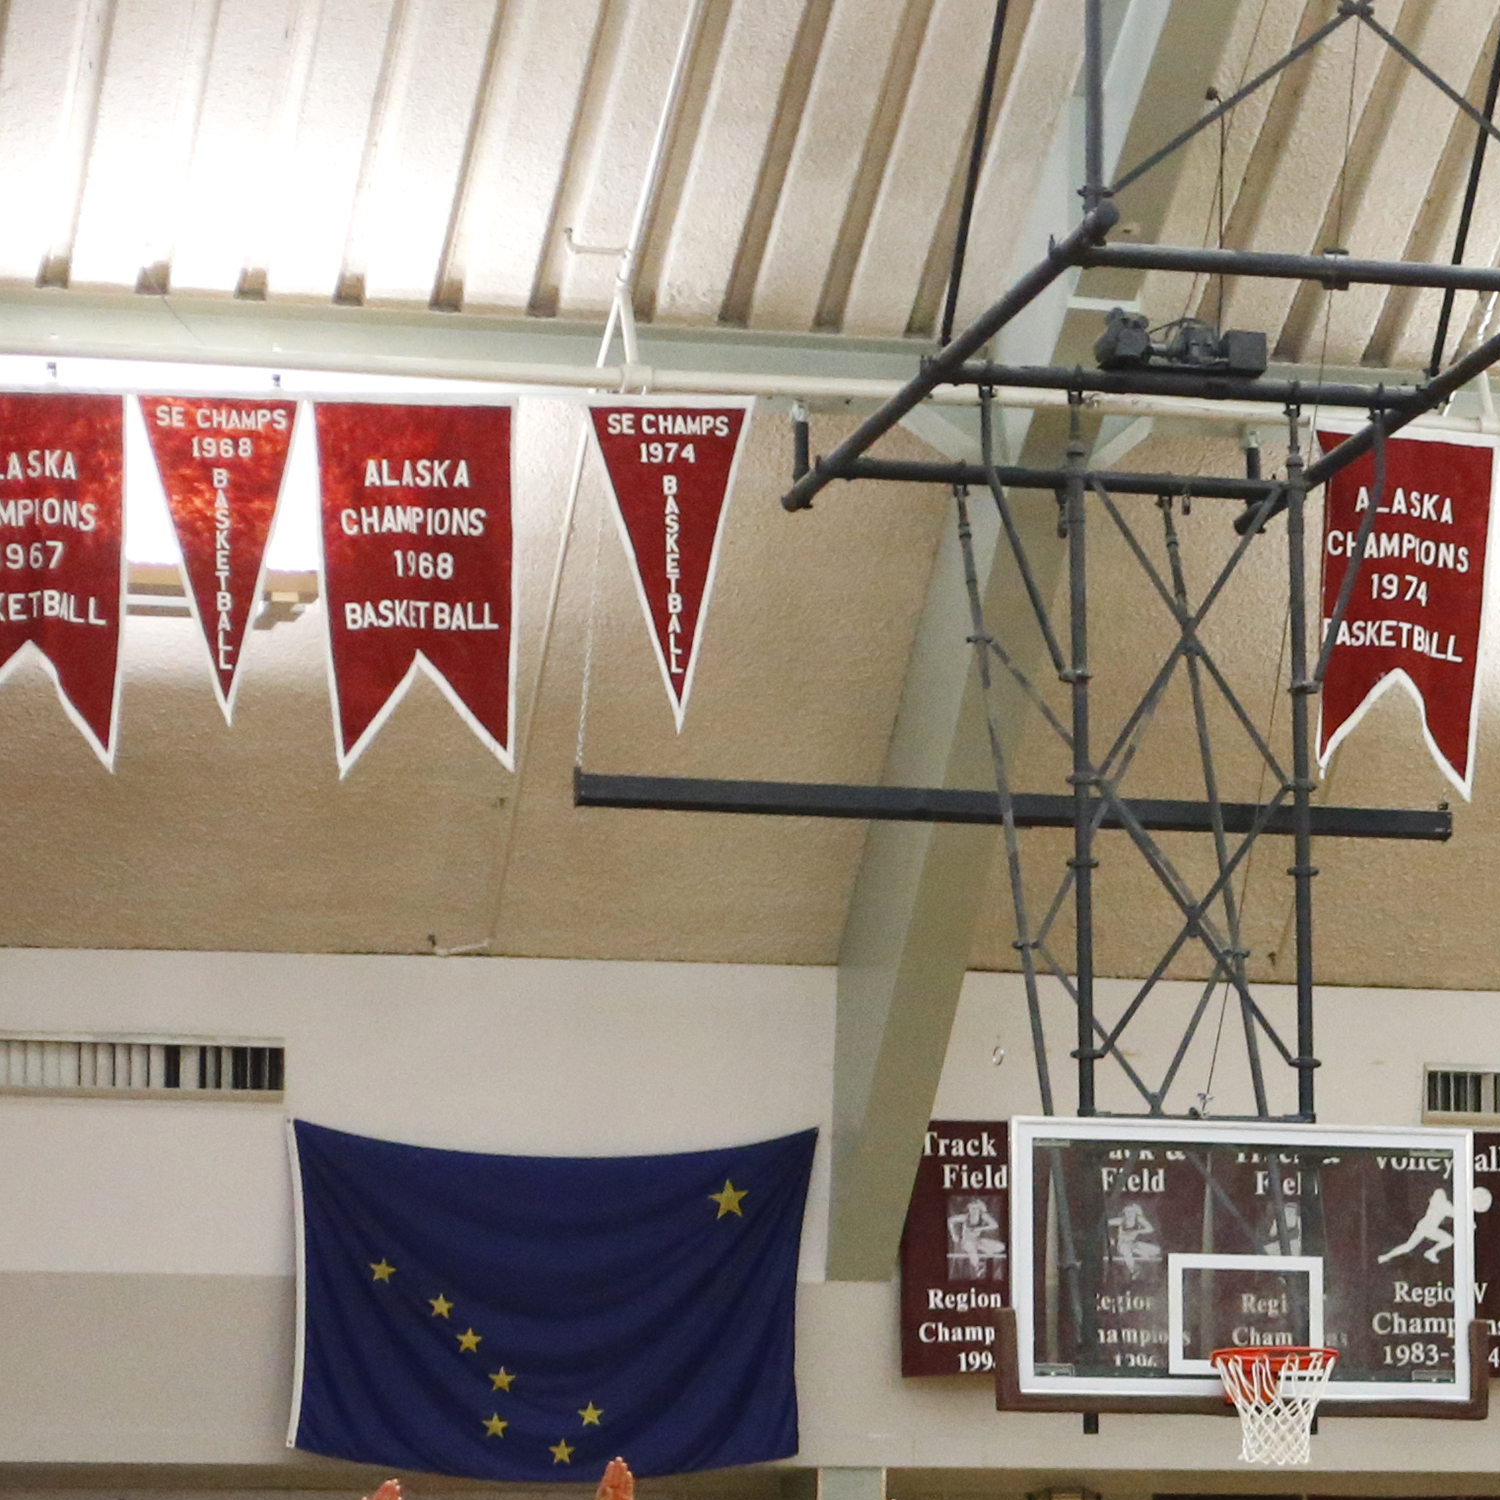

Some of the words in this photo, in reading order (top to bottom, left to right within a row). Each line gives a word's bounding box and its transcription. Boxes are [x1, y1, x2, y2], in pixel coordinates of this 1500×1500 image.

[156, 405, 185, 427] SE
[196, 409, 287, 430] CHAMPS
[608, 414, 636, 434] SE
[642, 414, 729, 438] CHAMPS
[191, 437, 253, 458] 1968
[639, 443, 696, 464] 1974
[364, 459, 470, 488] ALASKA
[341, 508, 485, 537] CHAMPIONS
[394, 549, 454, 579] 1968
[1372, 573, 1428, 607] 1974
[344, 602, 499, 631] BASKETBALL
[924, 1131, 997, 1156] Track
[942, 1164, 1008, 1189] Field
